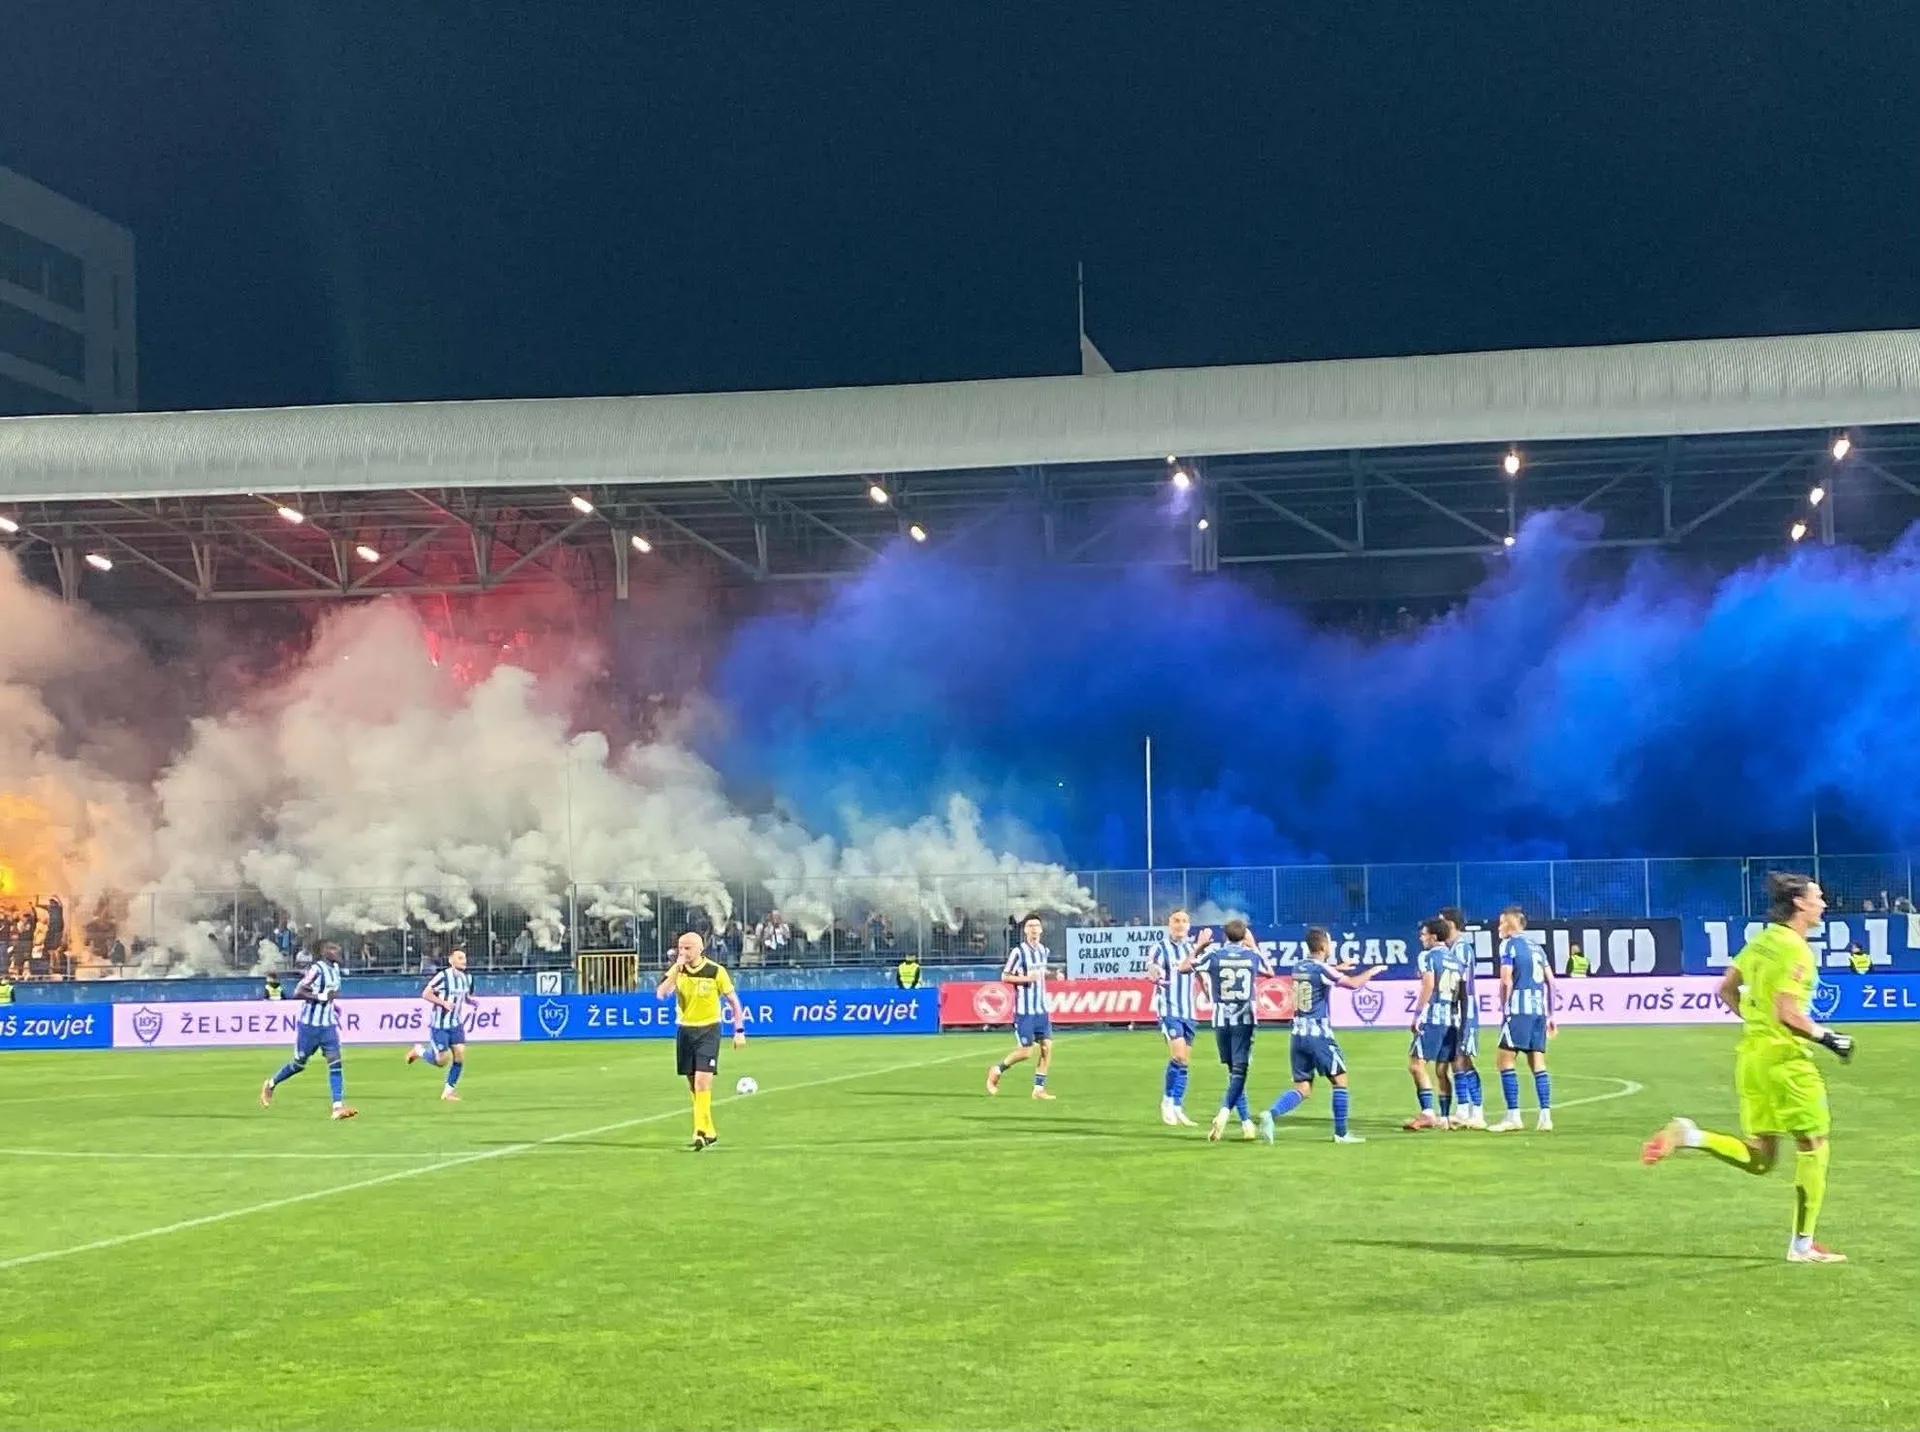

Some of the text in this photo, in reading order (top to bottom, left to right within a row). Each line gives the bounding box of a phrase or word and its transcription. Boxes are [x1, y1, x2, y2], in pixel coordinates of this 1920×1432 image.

[1078, 930, 1164, 945] VOLIM MAJKO
[1093, 962, 1120, 974] SVOG
[1218, 968, 1252, 1001] 23
[1625, 986, 1676, 1011] naš
[379, 1008, 422, 1030] naš
[587, 997, 920, 1027] ŽELJEČAR naš zavjet
[22, 1013, 95, 1041] zavjet
